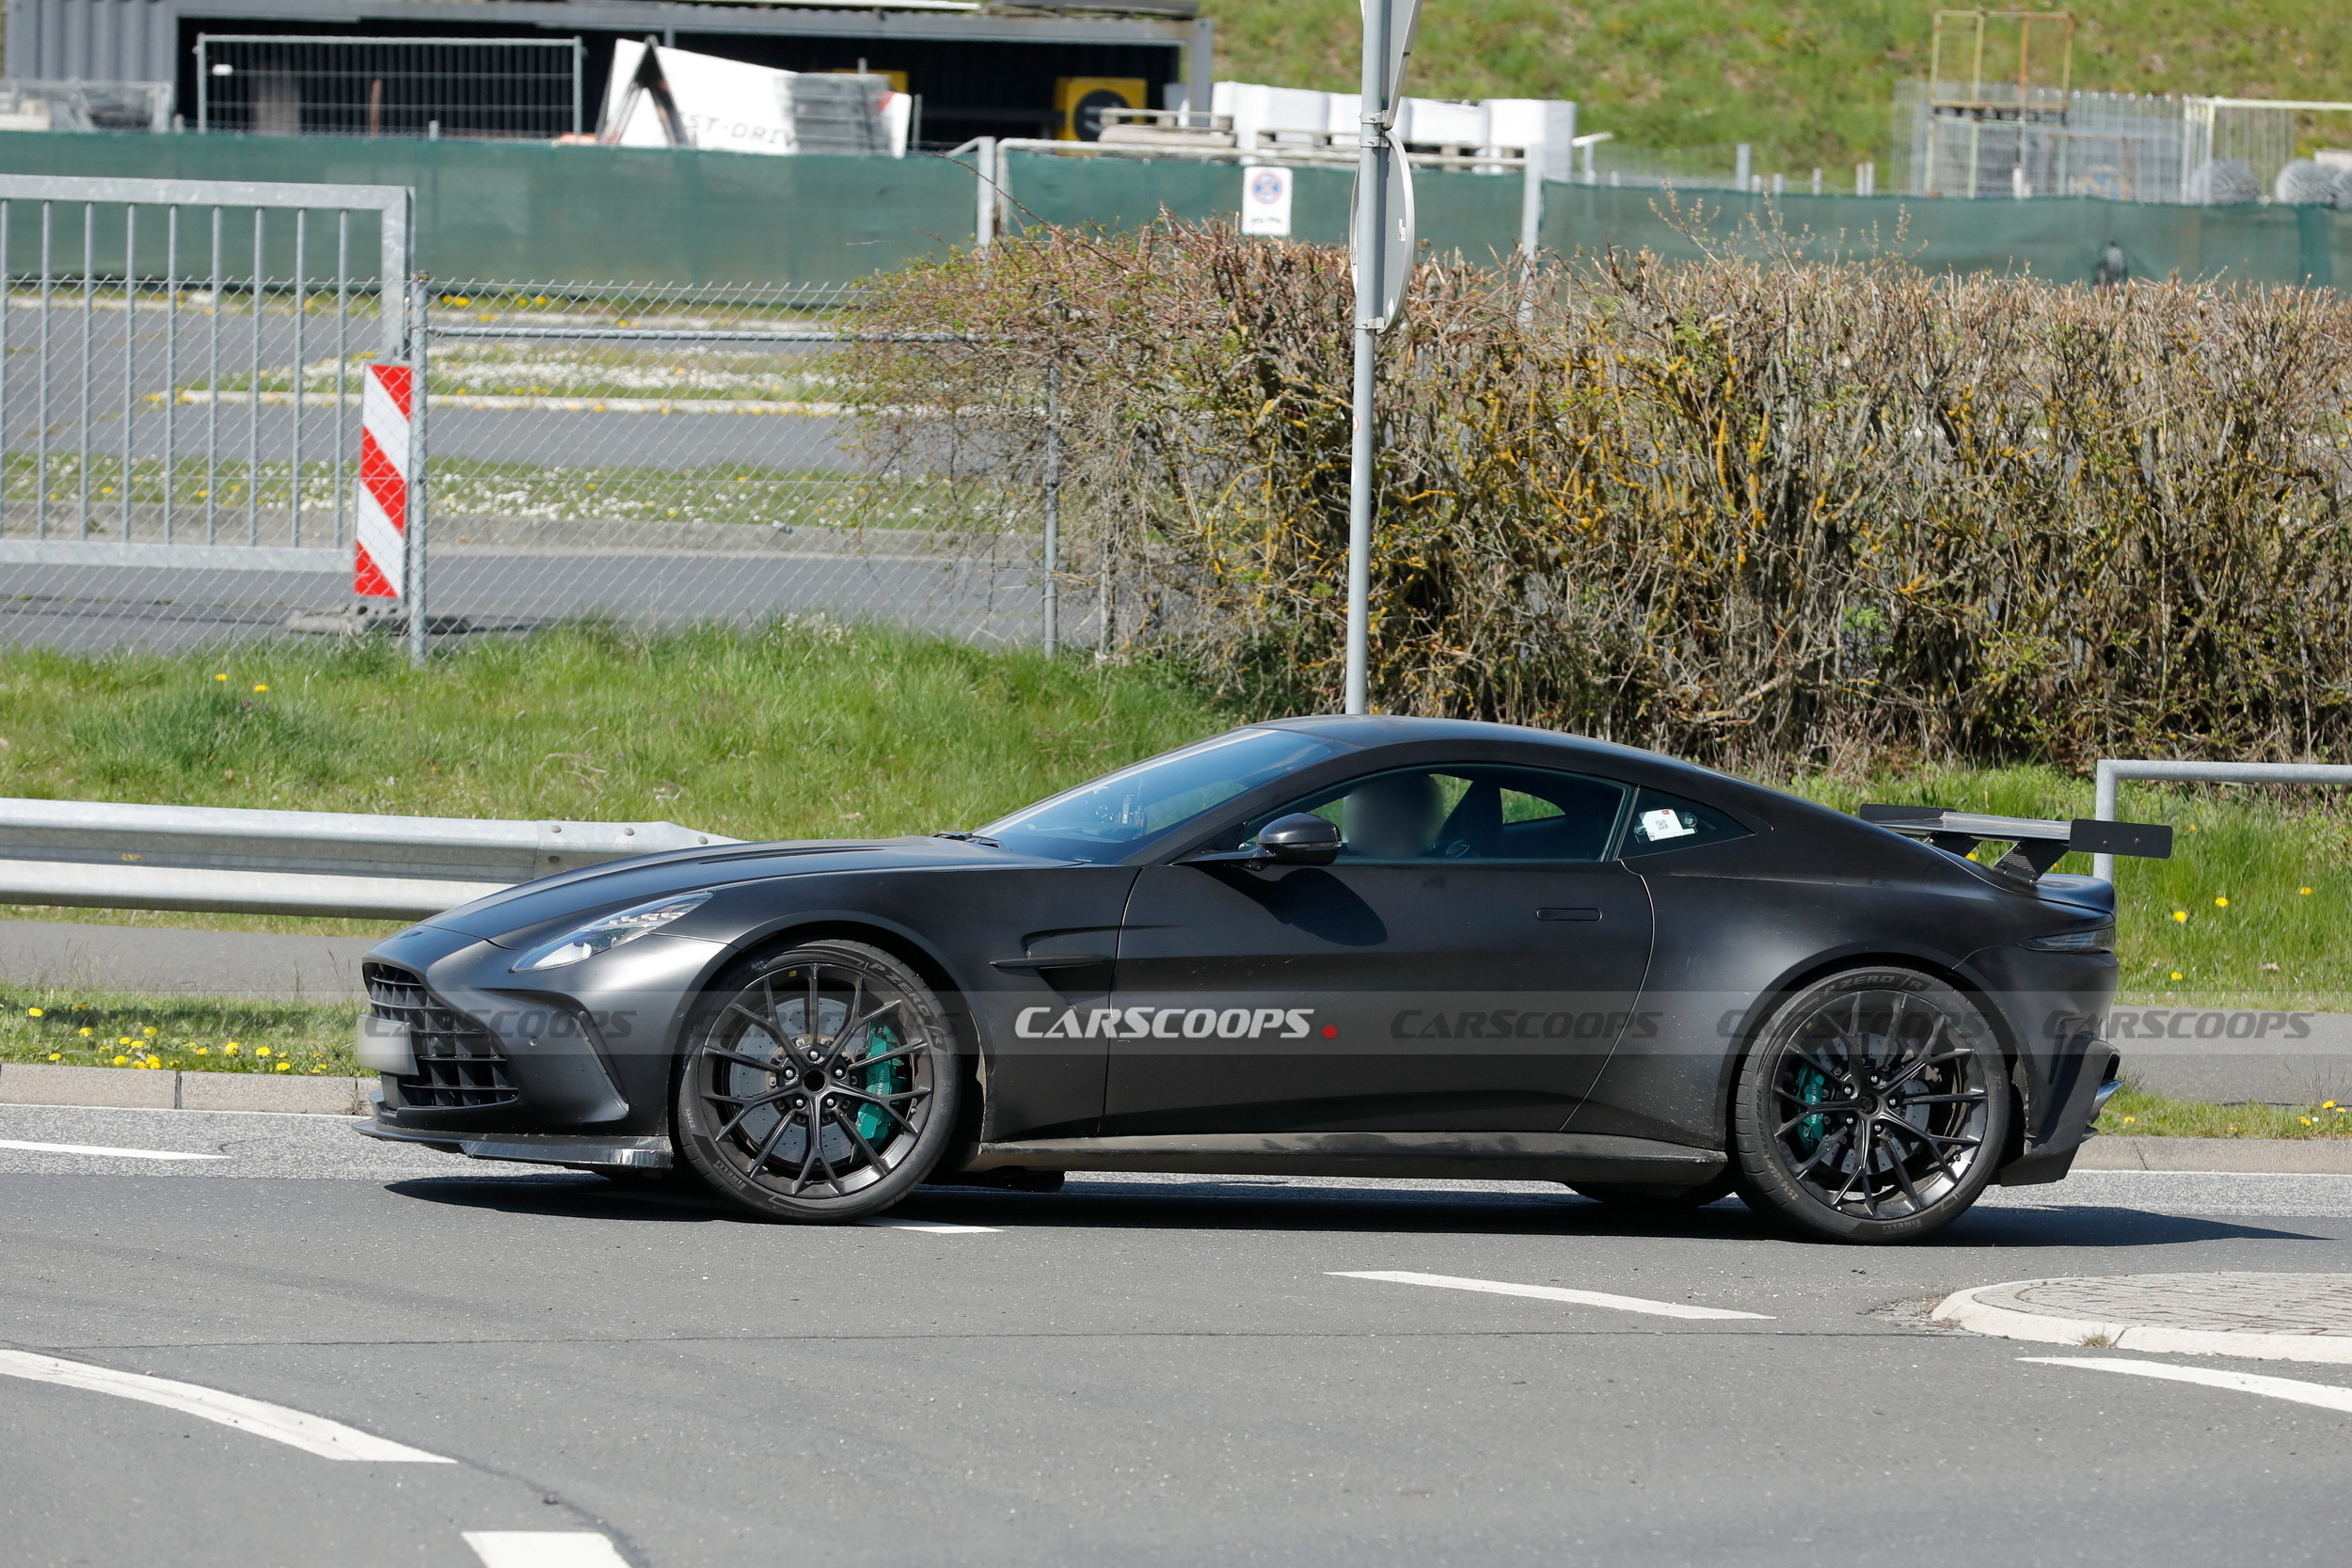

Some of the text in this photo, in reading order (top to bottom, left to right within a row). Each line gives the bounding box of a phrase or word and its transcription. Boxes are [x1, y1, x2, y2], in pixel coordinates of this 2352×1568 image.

[869, 962, 885, 972] P
[885, 972, 933, 1017] ZERO
[1840, 974, 1896, 990] ZERO
[714, 1159, 747, 1192] PIRELLI
